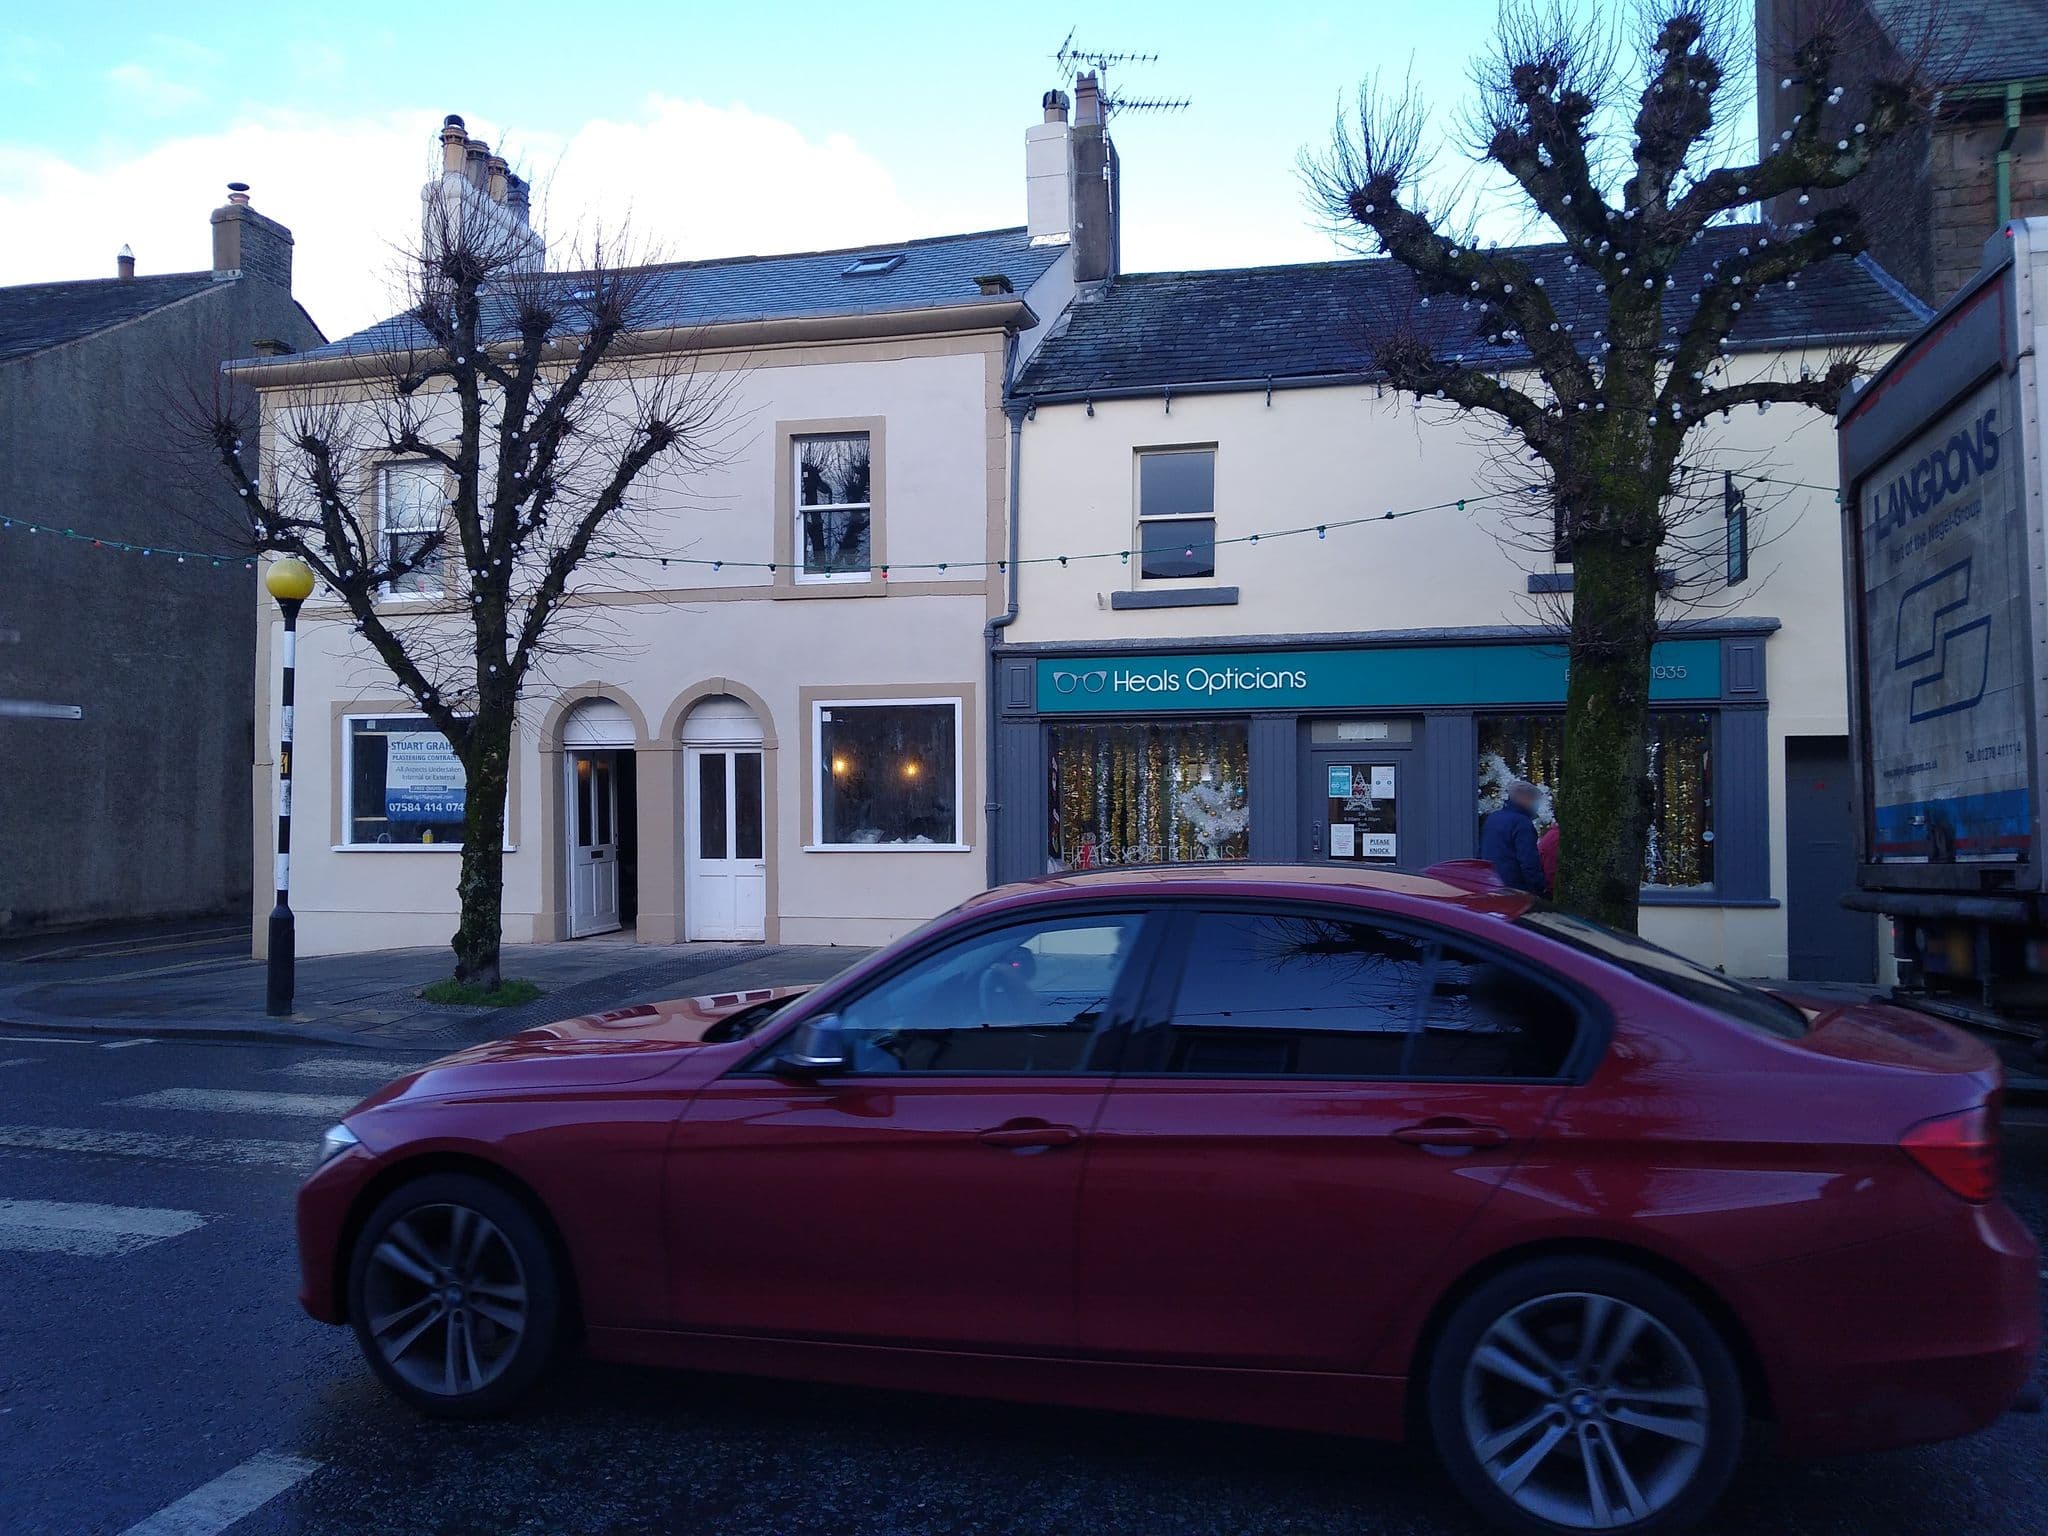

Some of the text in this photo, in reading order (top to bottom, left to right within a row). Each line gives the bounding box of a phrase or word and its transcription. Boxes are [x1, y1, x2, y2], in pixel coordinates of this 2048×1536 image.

[1873, 408, 1999, 541] LANGDONS
[1905, 535, 1912, 556] of
[1913, 532, 1927, 551] the
[1650, 665, 1687, 680] 1935
[1113, 666, 1307, 696] Heals Opticians
[391, 741, 423, 751] STUART
[404, 766, 427, 774] Aspects
[389, 802, 465, 812] 07584 414 074
